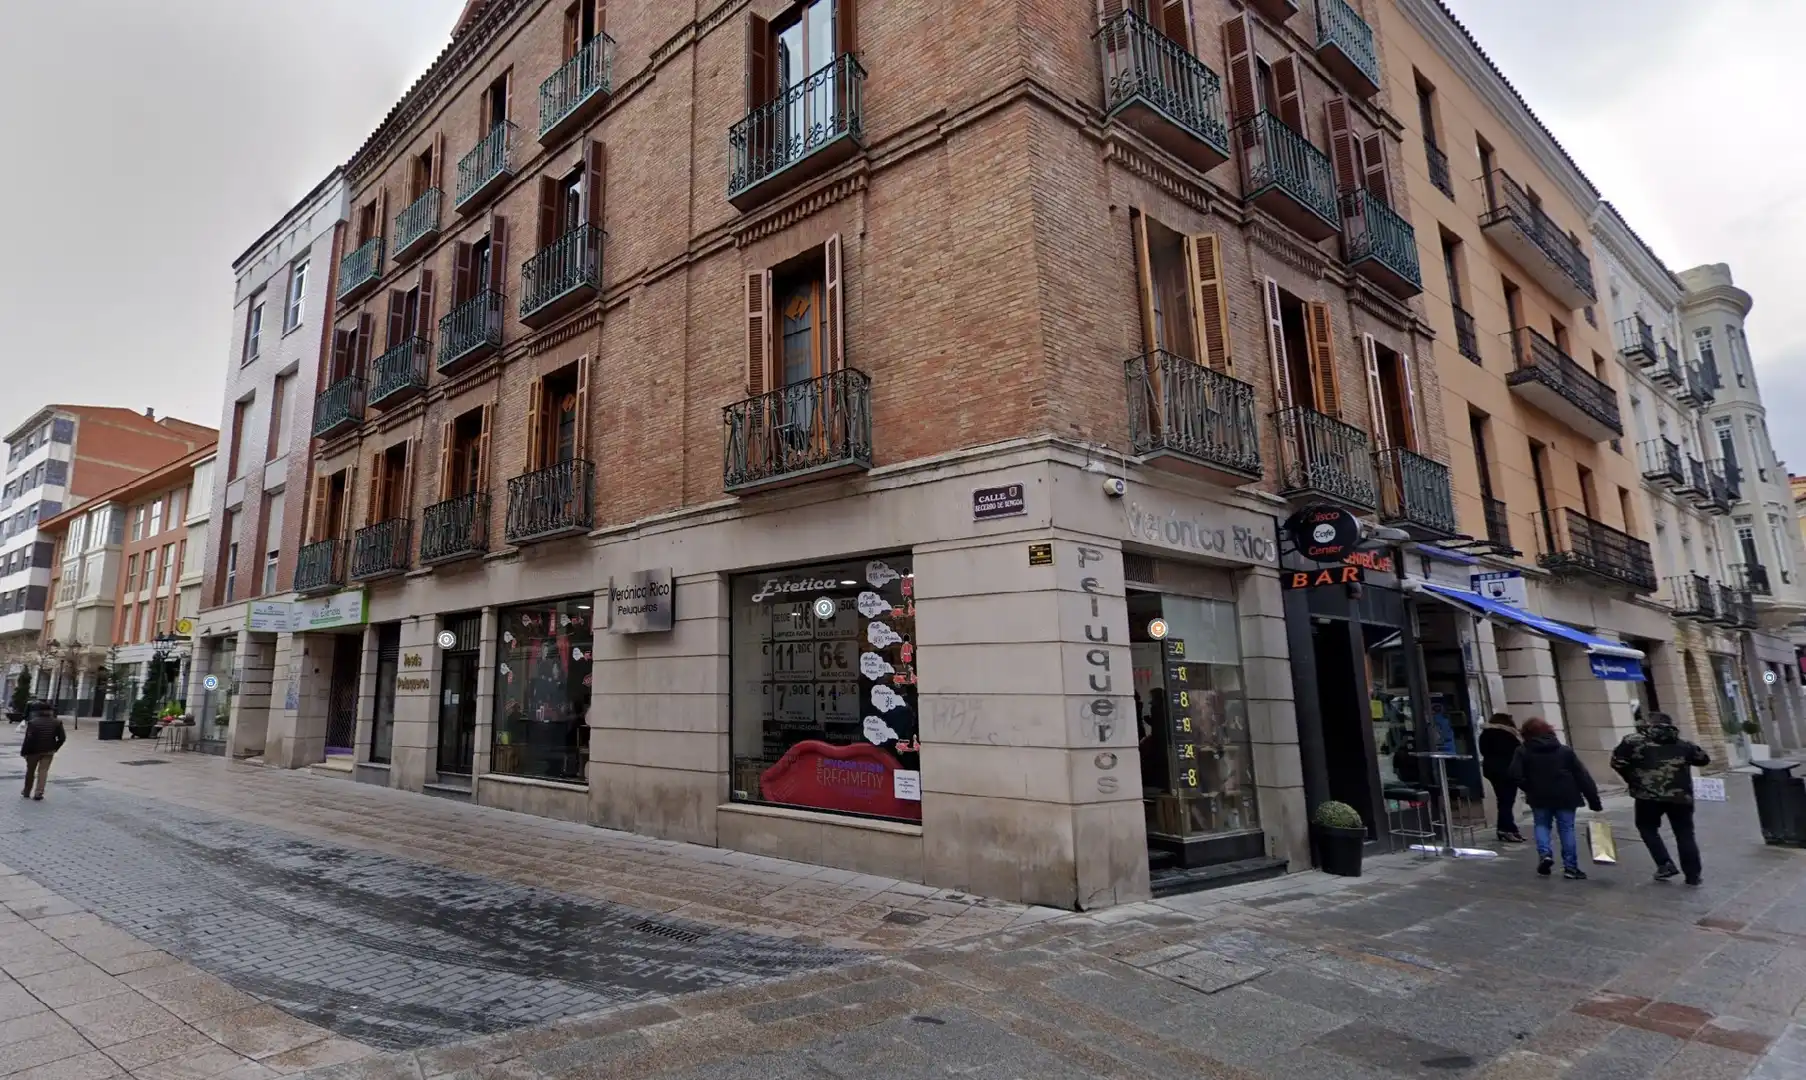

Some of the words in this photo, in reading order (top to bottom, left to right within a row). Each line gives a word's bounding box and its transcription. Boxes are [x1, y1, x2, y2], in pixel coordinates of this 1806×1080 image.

[978, 493, 1006, 503] CALLE
[997, 501, 1004, 509] DE
[1129, 501, 1226, 553] Verónica
[1231, 525, 1276, 562] Rico
[1314, 529, 1335, 539] Café
[1308, 545, 1345, 557] Center
[1291, 566, 1361, 589] BAR
[610, 584, 648, 601] Verónica
[649, 581, 670, 597] Rico
[751, 578, 837, 602] Estetica
[617, 603, 658, 615] Peluqueros
[819, 642, 848, 670] 6€
[1077, 547, 1119, 795] Peluqueros
